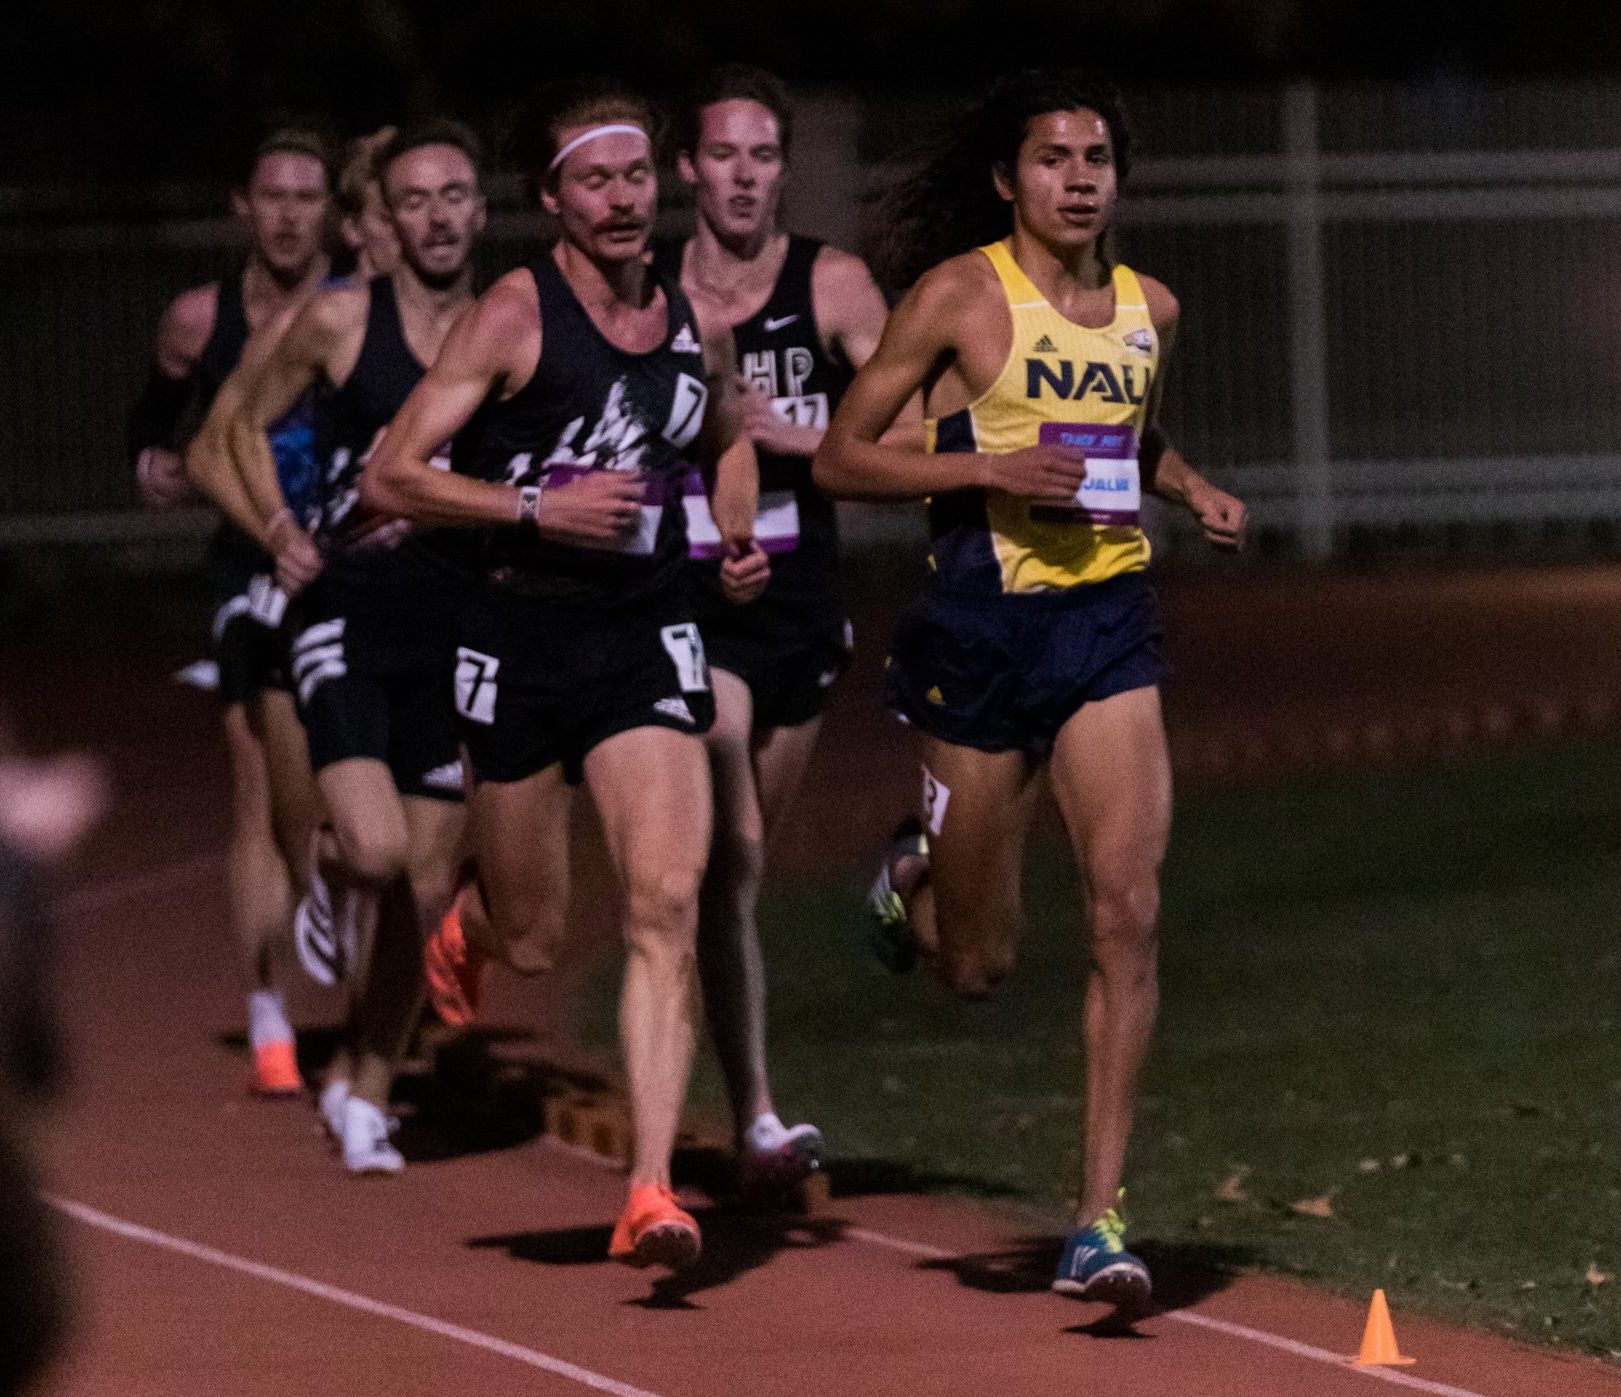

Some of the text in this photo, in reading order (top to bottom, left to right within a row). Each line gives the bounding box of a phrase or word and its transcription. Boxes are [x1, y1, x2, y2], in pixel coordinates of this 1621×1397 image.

[1025, 358, 1151, 405] NAU
[673, 384, 703, 439] 7
[465, 656, 487, 712] 7
[671, 630, 699, 685] 7
